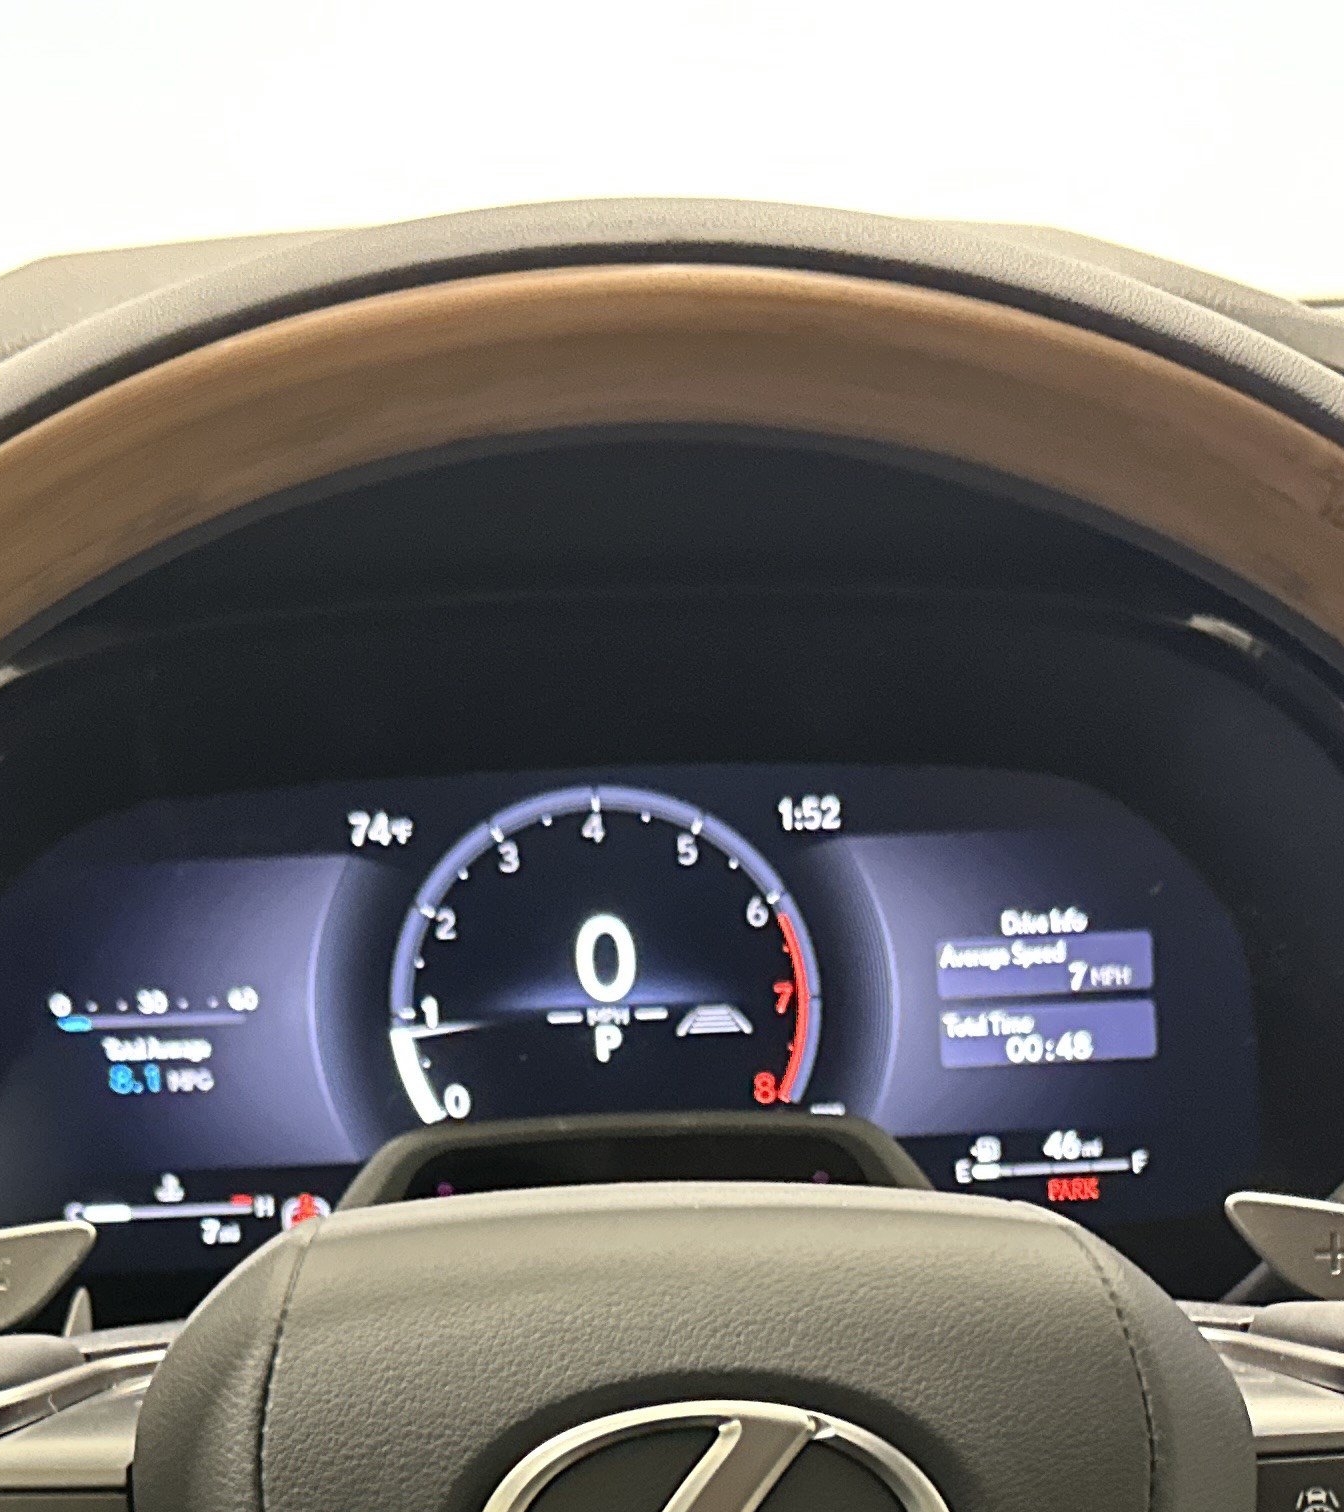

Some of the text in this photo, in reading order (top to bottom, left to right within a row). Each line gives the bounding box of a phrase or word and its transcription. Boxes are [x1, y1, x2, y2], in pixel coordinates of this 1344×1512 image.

[581, 815, 606, 843] 4
[778, 794, 842, 831] 1:52
[498, 840, 520, 874] 3
[676, 834, 698, 866] 5
[435, 909, 457, 940] 2
[746, 896, 769, 928] 6
[575, 914, 637, 1003] 0
[1068, 960, 1088, 991] 7
[421, 995, 439, 1030] 1
[773, 980, 794, 1014] 7
[989, 1009, 1035, 1036] Time
[594, 1023, 623, 1063] P
[1006, 1030, 1094, 1064] 00:48
[108, 1062, 162, 1095] 8.1
[753, 1071, 777, 1105] 8
[444, 1082, 472, 1119] 0
[1047, 1177, 1100, 1202] PARK
